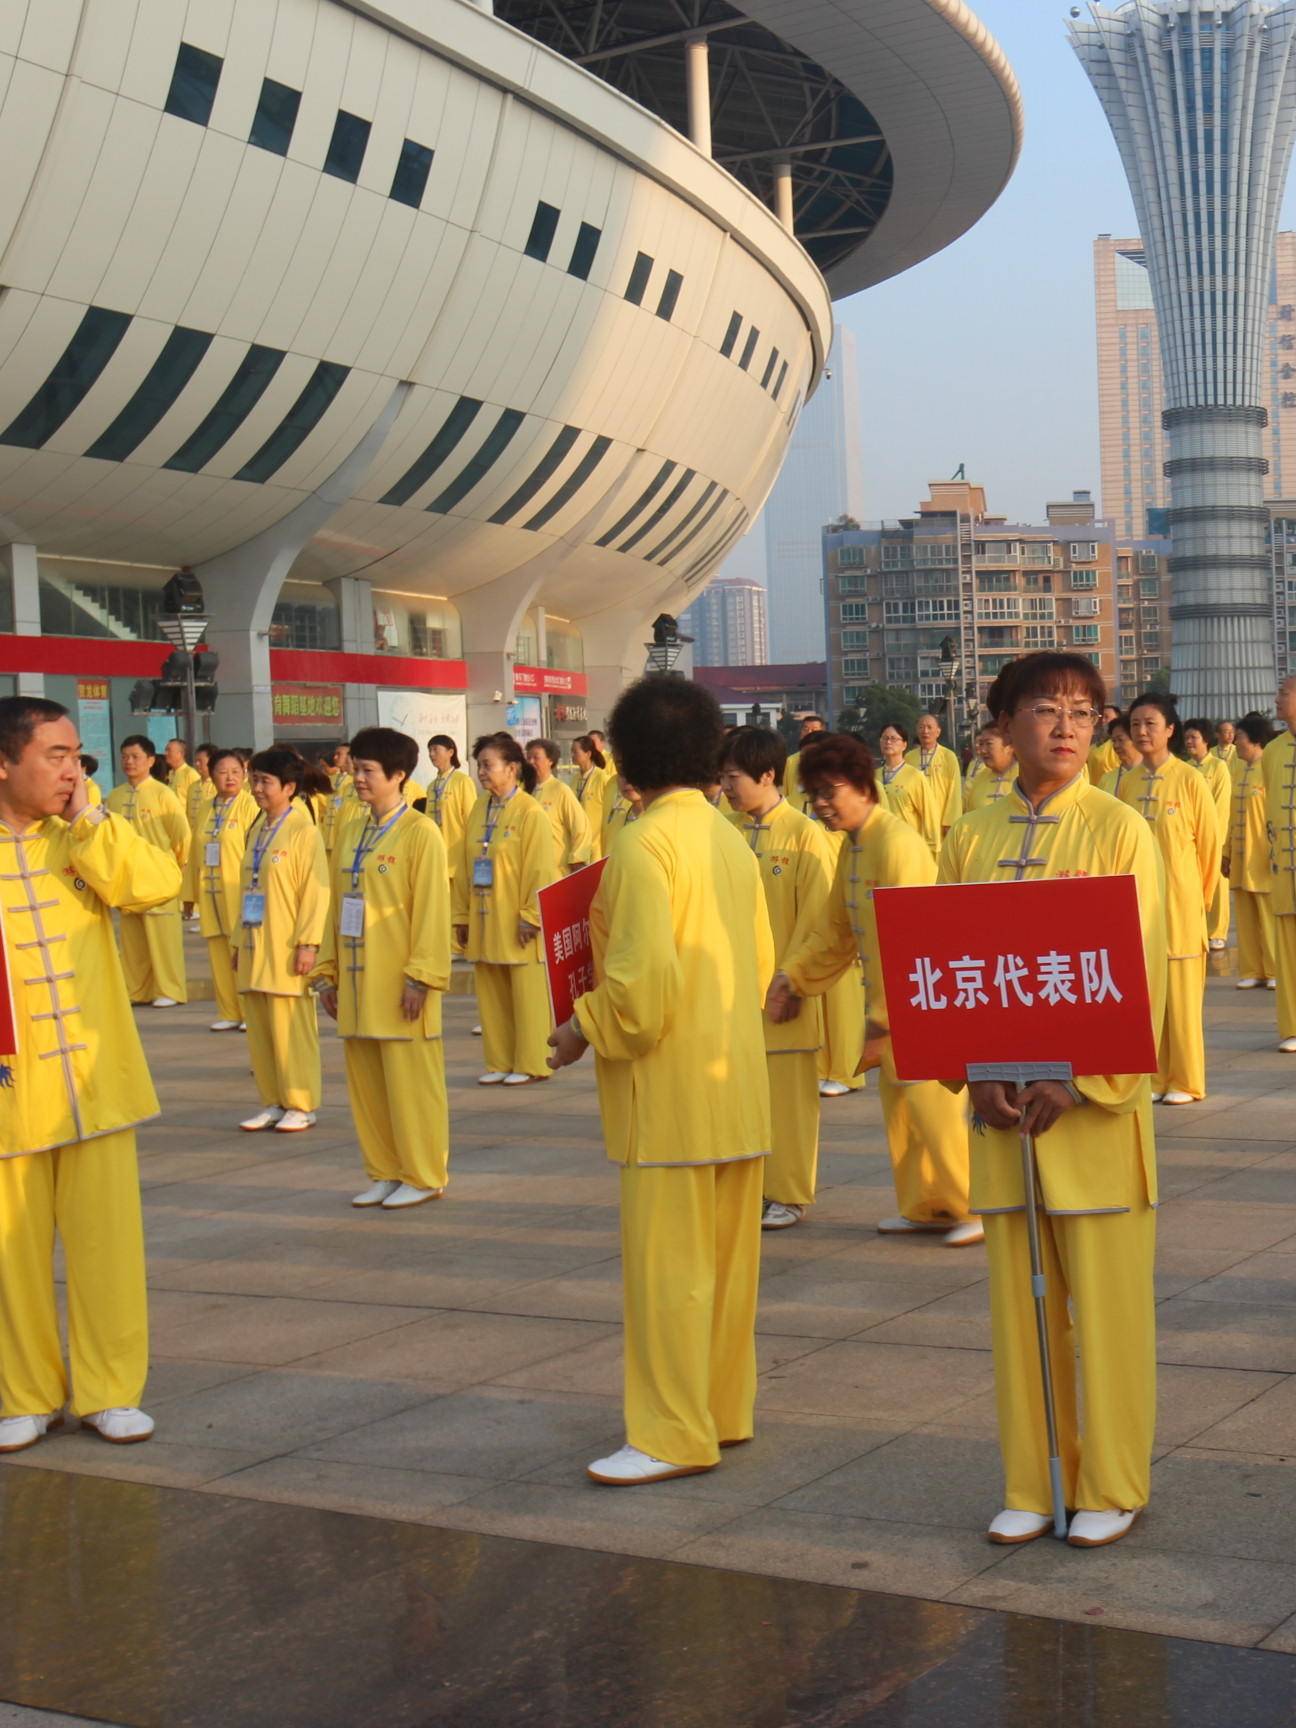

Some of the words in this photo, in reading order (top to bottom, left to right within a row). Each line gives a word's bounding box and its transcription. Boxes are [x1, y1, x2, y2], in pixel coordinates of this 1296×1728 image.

[908, 948, 1123, 1011] 北京代表队
